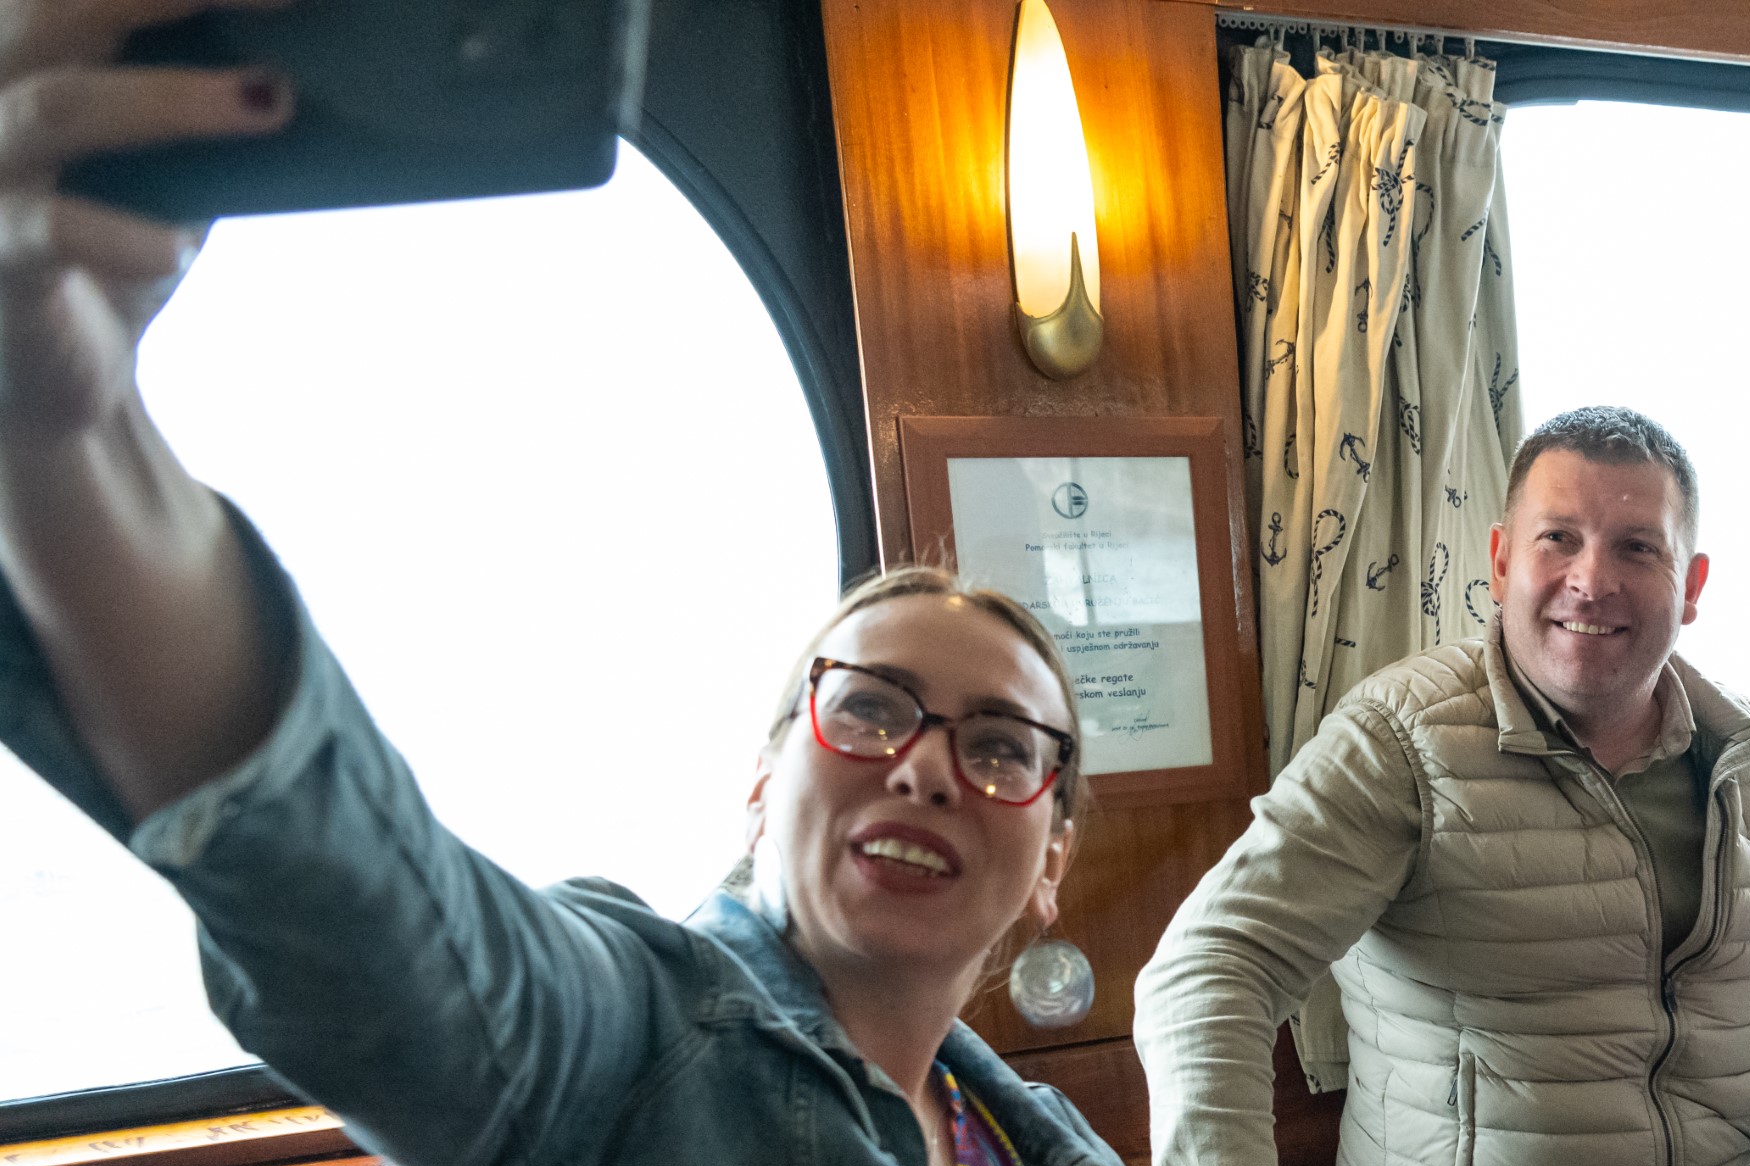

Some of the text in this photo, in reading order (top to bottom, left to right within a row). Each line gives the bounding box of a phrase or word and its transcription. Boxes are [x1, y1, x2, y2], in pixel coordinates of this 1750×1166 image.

[1076, 629, 1095, 641] koju
[1097, 629, 1111, 637] ste
[1114, 627, 1141, 639] pružili
[1066, 643, 1111, 654] uspješnom
[1113, 640, 1160, 651] održavanju
[1075, 673, 1134, 685] ečke regate
[1107, 687, 1147, 699] veslanju
